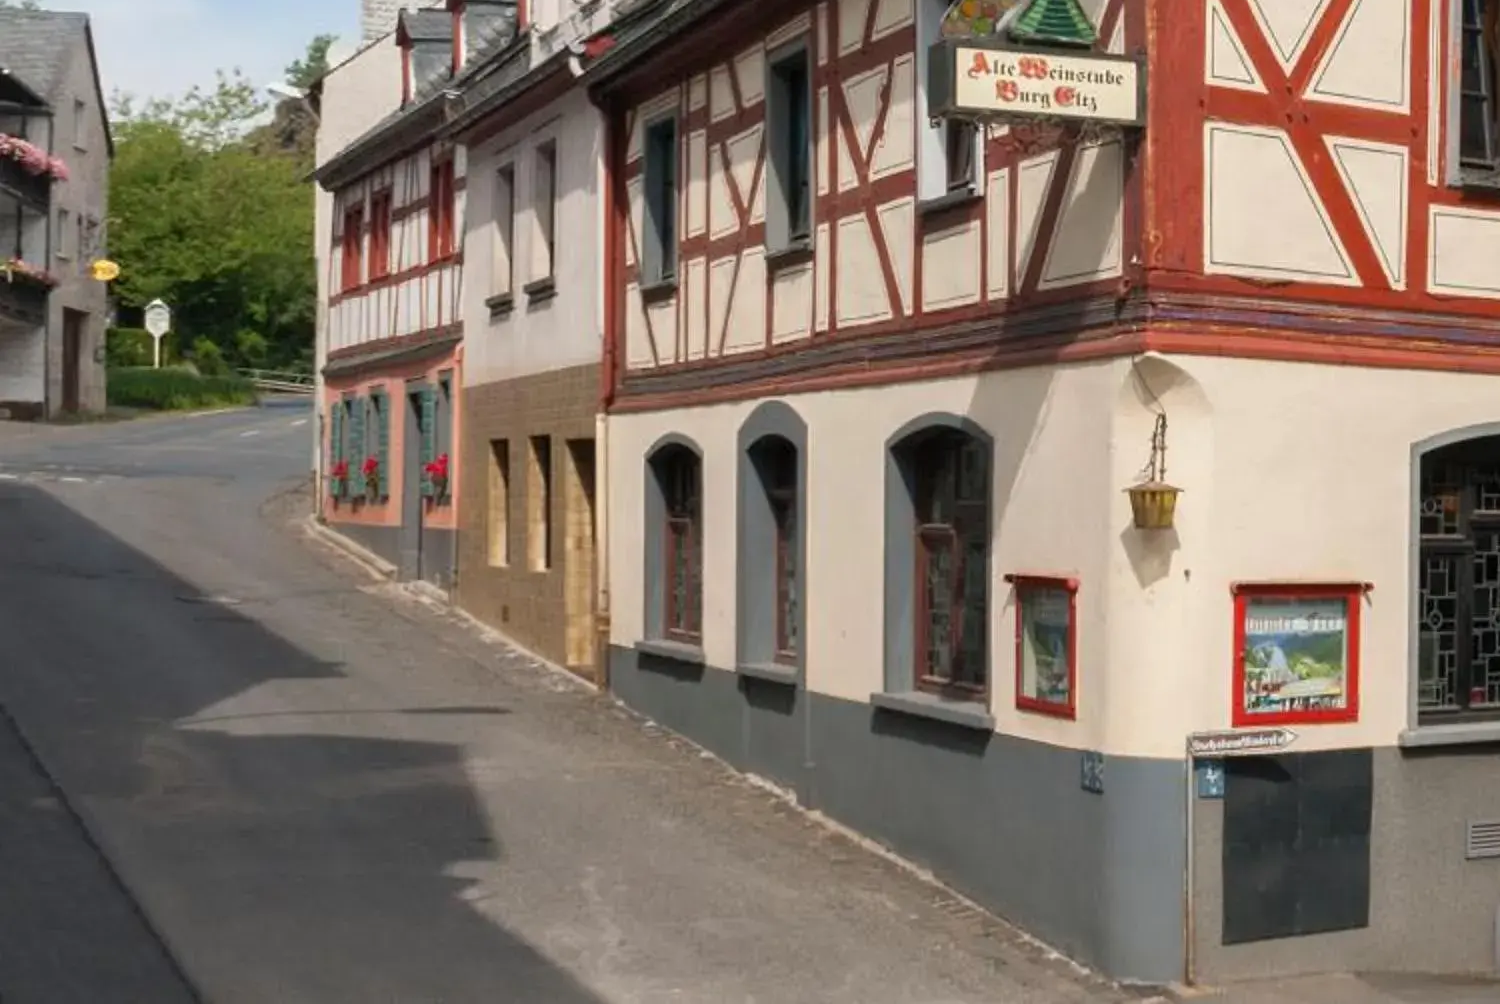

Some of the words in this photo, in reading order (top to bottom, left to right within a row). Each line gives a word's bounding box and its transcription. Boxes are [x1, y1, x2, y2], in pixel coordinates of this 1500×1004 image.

[968, 52, 1016, 79] Alte
[1018, 56, 1124, 85] Weinstube
[996, 79, 1050, 108] Burg
[1054, 86, 1097, 112] Eltz
